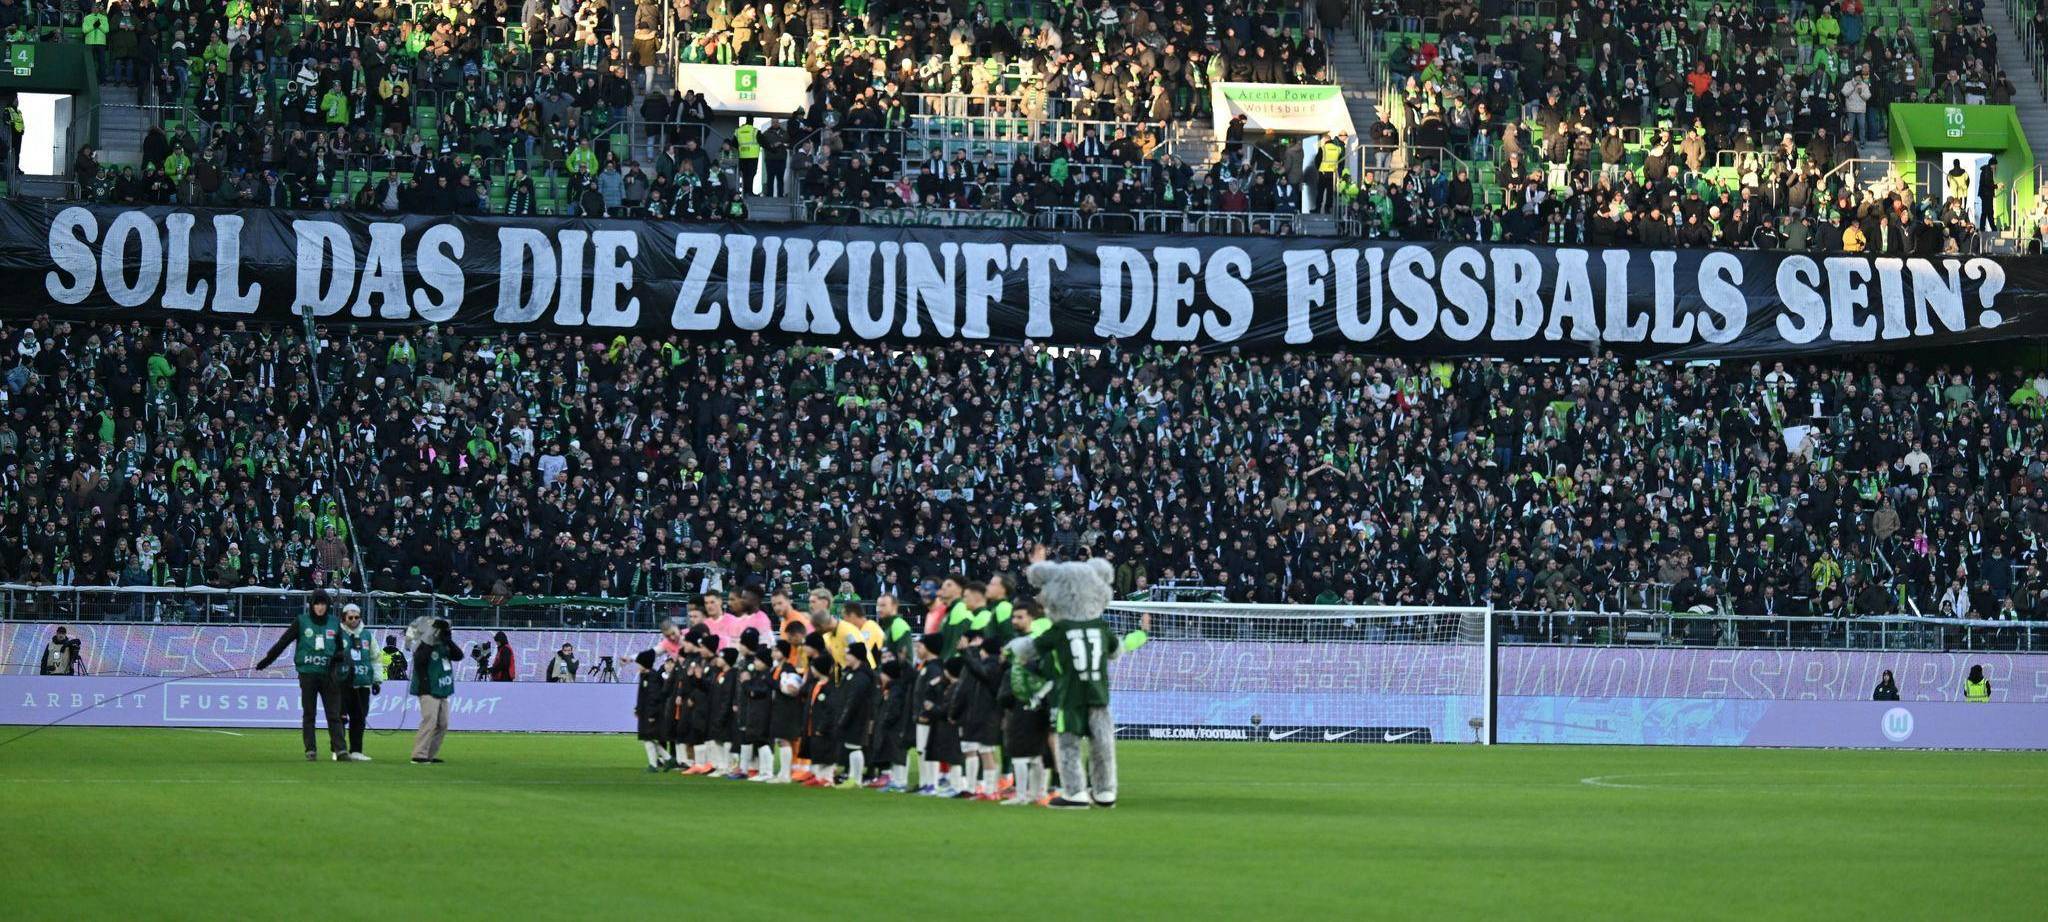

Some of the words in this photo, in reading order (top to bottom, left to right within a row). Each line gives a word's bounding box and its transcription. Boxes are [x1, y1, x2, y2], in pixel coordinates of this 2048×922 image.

[18, 50, 28, 62] 4
[741, 74, 752, 88] 6
[1239, 89, 1278, 100] Arena
[1284, 89, 1323, 100] Power
[1946, 112, 1964, 125] 10
[46, 206, 262, 313] SOLL
[291, 219, 466, 323] DAS
[493, 227, 641, 328] DIE
[670, 231, 1068, 340] ZUKUNFT
[1093, 245, 1254, 343] DES
[1282, 244, 1748, 345] FUSSBALLS
[1775, 255, 2007, 345] SEIN?
[304, 655, 330, 666] HOS
[22, 692, 146, 709] ARBEIT
[179, 694, 325, 711] FUSSBAL
[1149, 728, 1248, 740] NIKE.COM/FOOTBALL
